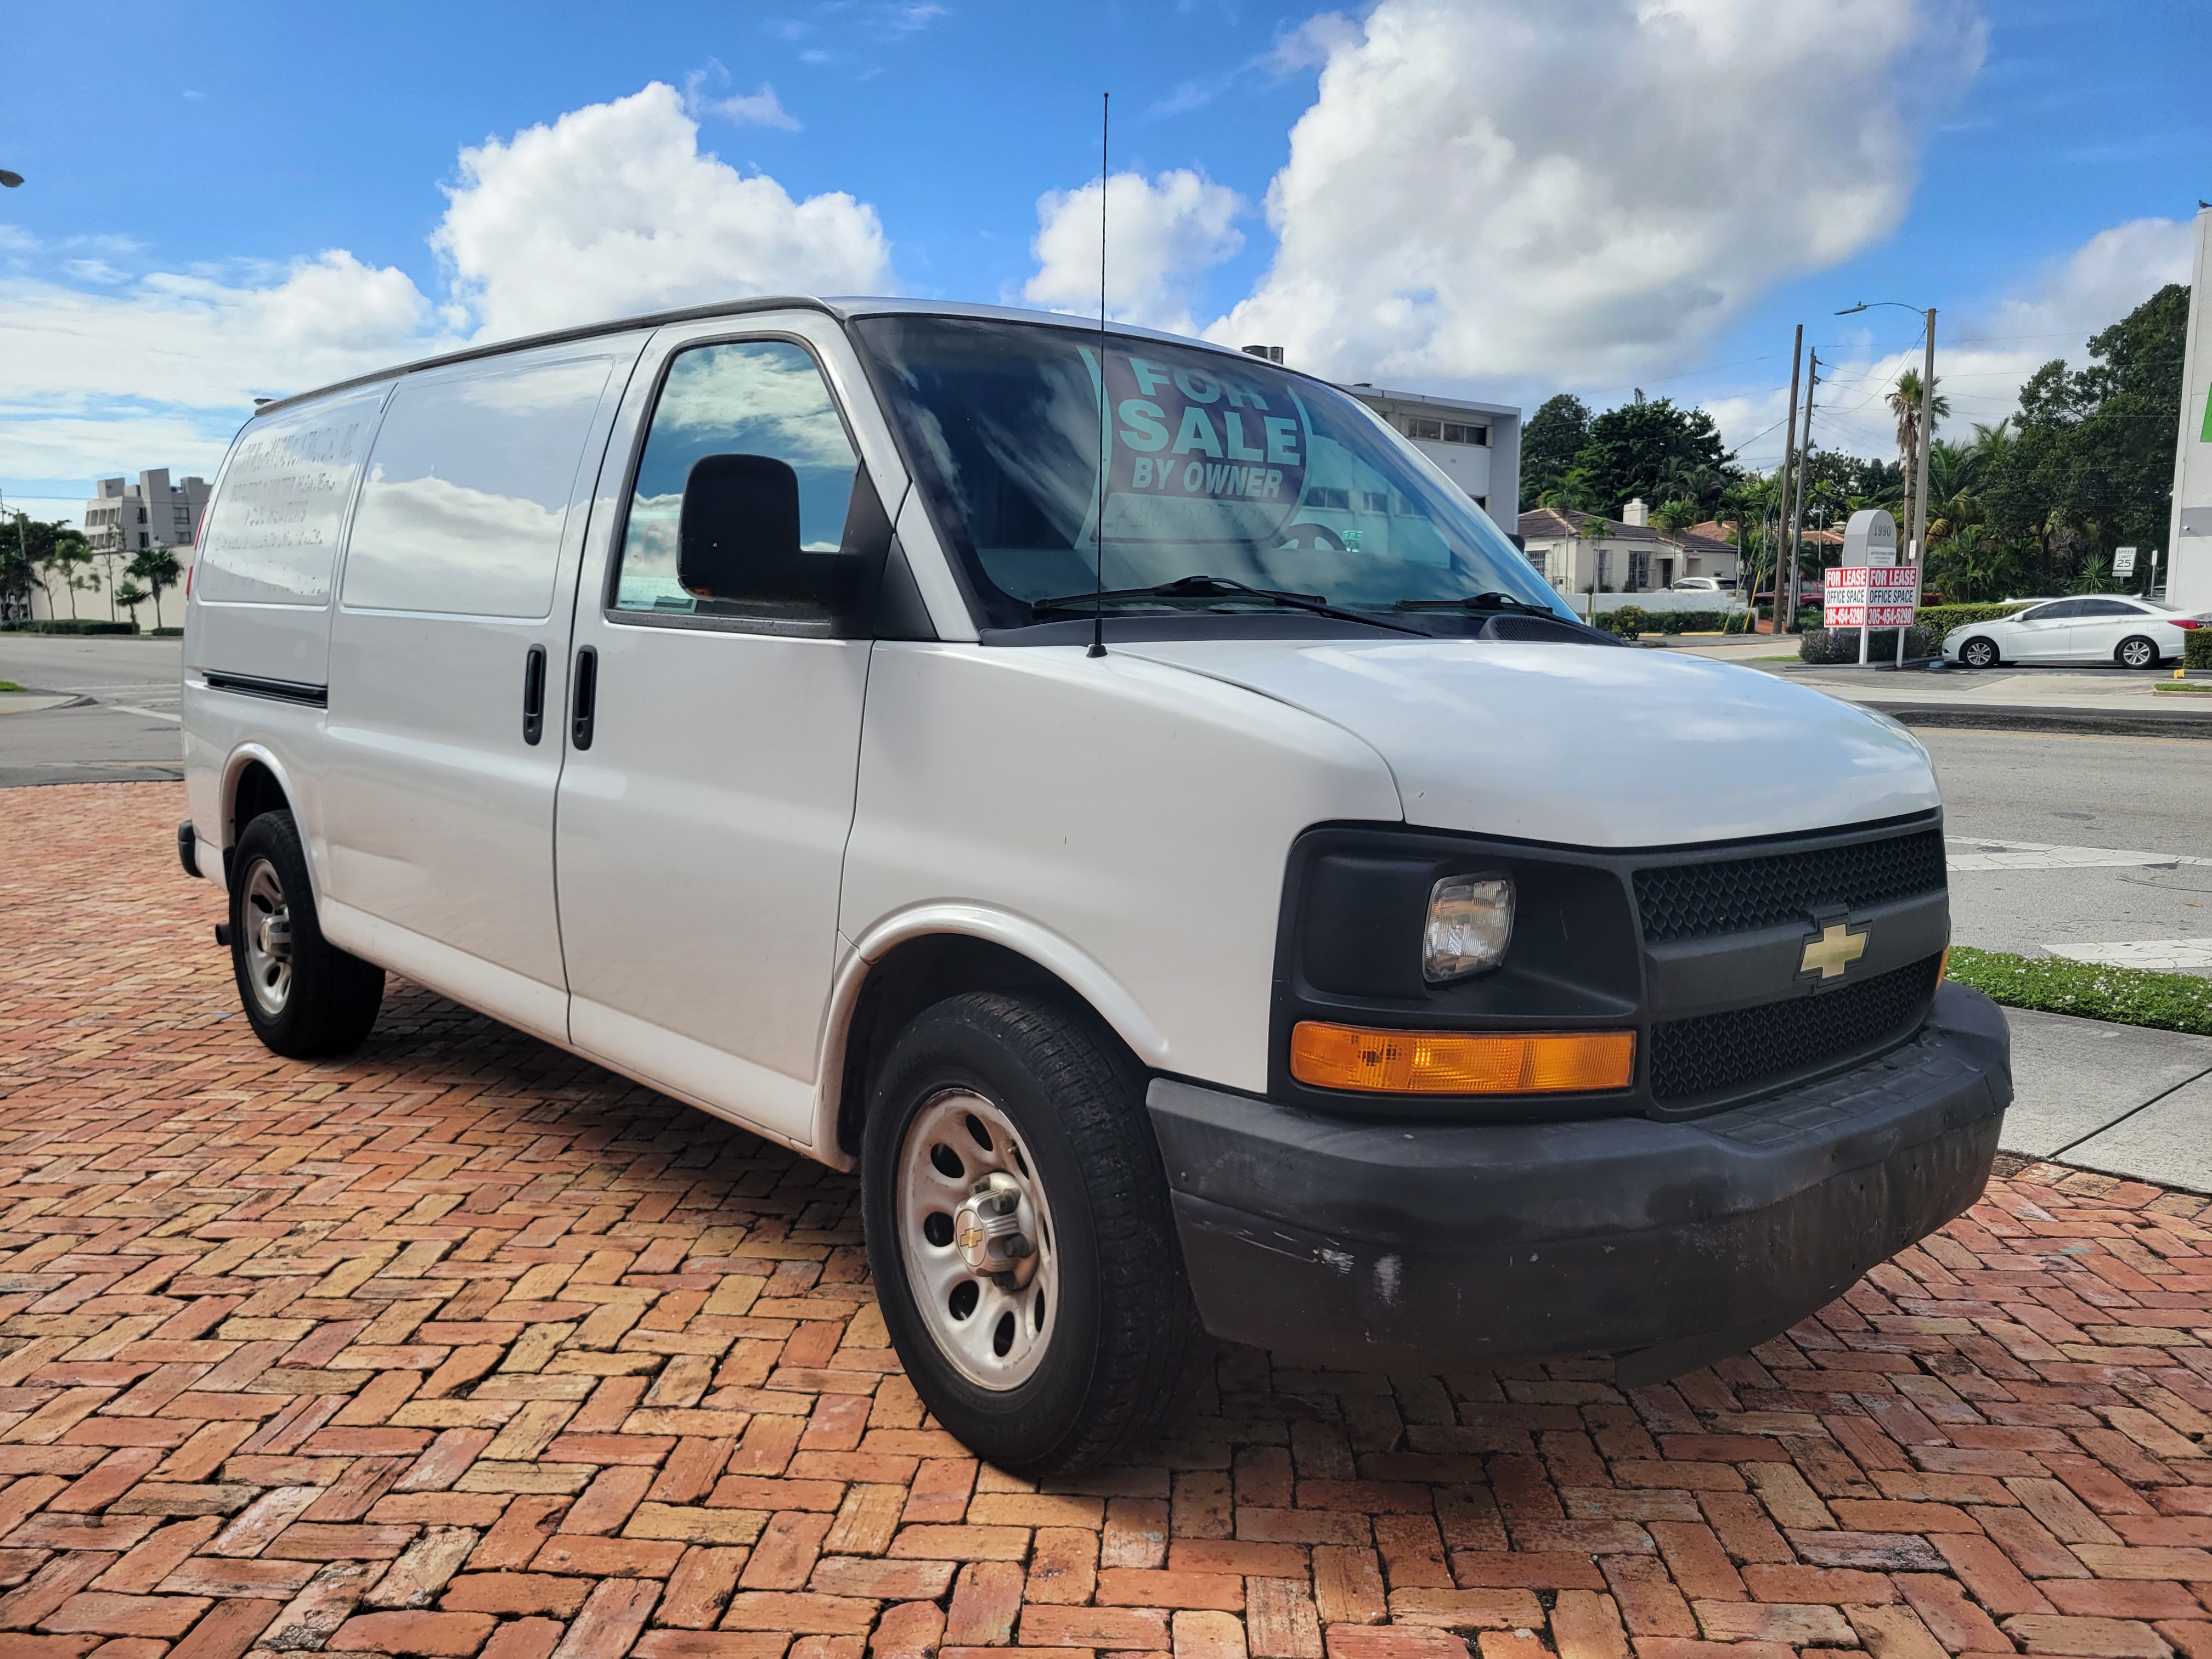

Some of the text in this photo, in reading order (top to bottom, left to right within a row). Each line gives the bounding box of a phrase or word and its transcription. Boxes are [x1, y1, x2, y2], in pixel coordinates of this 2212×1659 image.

[1129, 358, 1269, 411] FOR
[1119, 399, 1300, 465] SALE
[1132, 457, 1283, 498] BY OWNER
[1874, 525, 1891, 537] 1990
[1827, 569, 1865, 586] FOR LEASE
[1870, 570, 1915, 586] FOR LEASE
[1827, 589, 1864, 604] OFFICE SPACE
[1870, 589, 1913, 603] OFFICE SPACE
[1826, 608, 1864, 625] 305-454-5298
[1867, 608, 1911, 625] 305-454-5298
